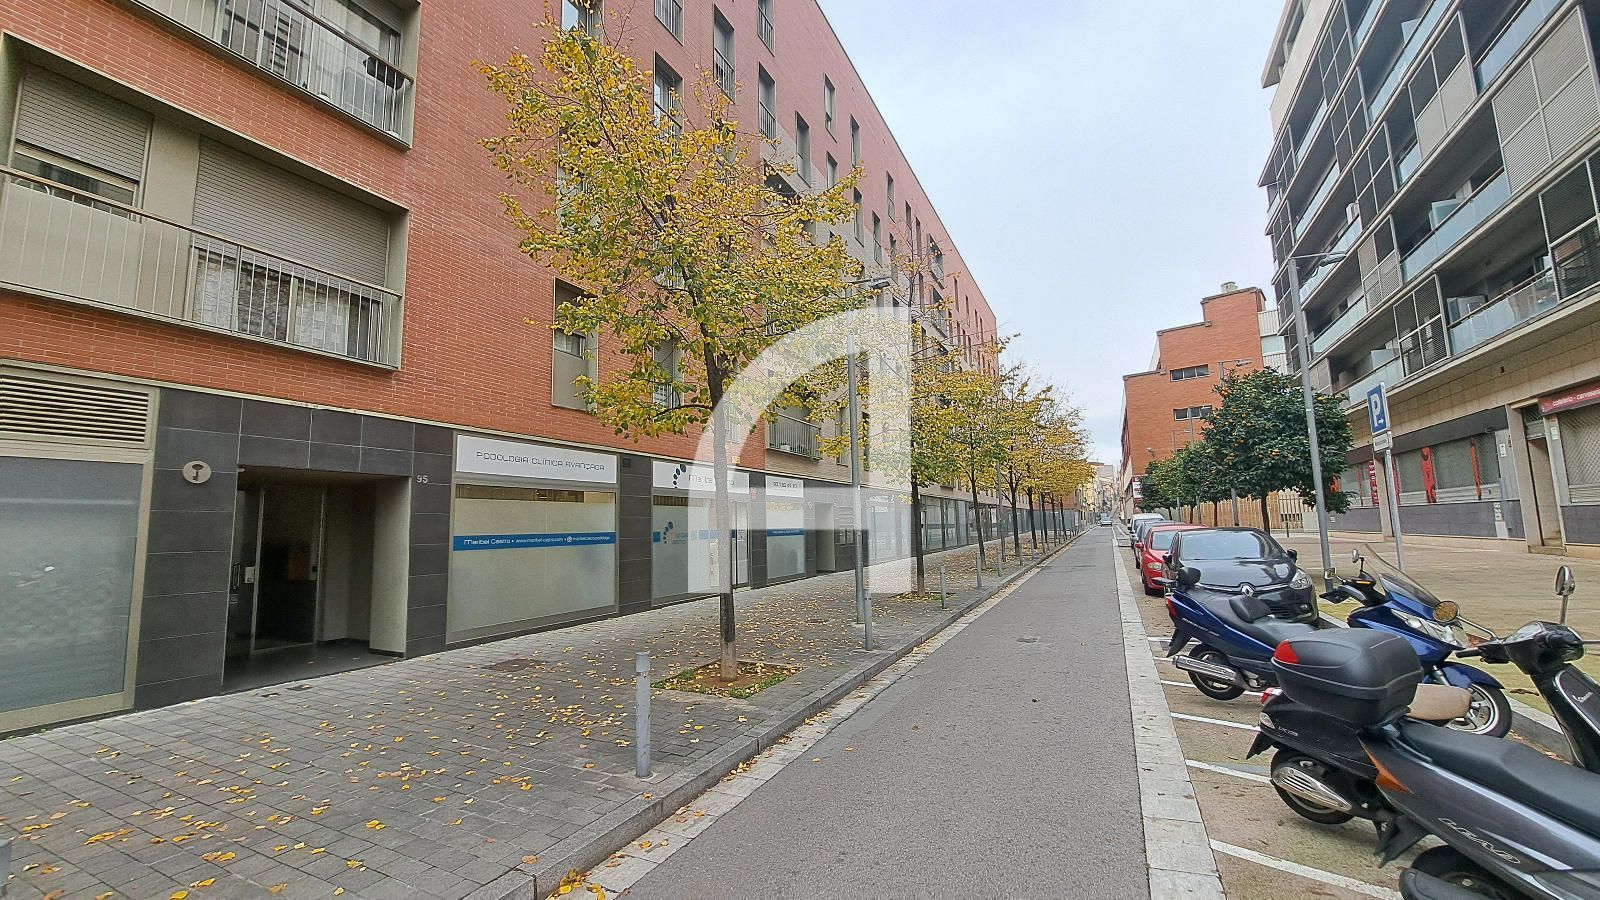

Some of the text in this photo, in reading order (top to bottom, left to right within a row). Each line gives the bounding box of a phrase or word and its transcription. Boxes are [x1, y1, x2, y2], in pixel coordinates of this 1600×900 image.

[1371, 393, 1381, 428] P
[476, 451, 529, 464] PODOLOGIA
[416, 474, 429, 484] 95
[1437, 817, 1521, 864] LEAD
